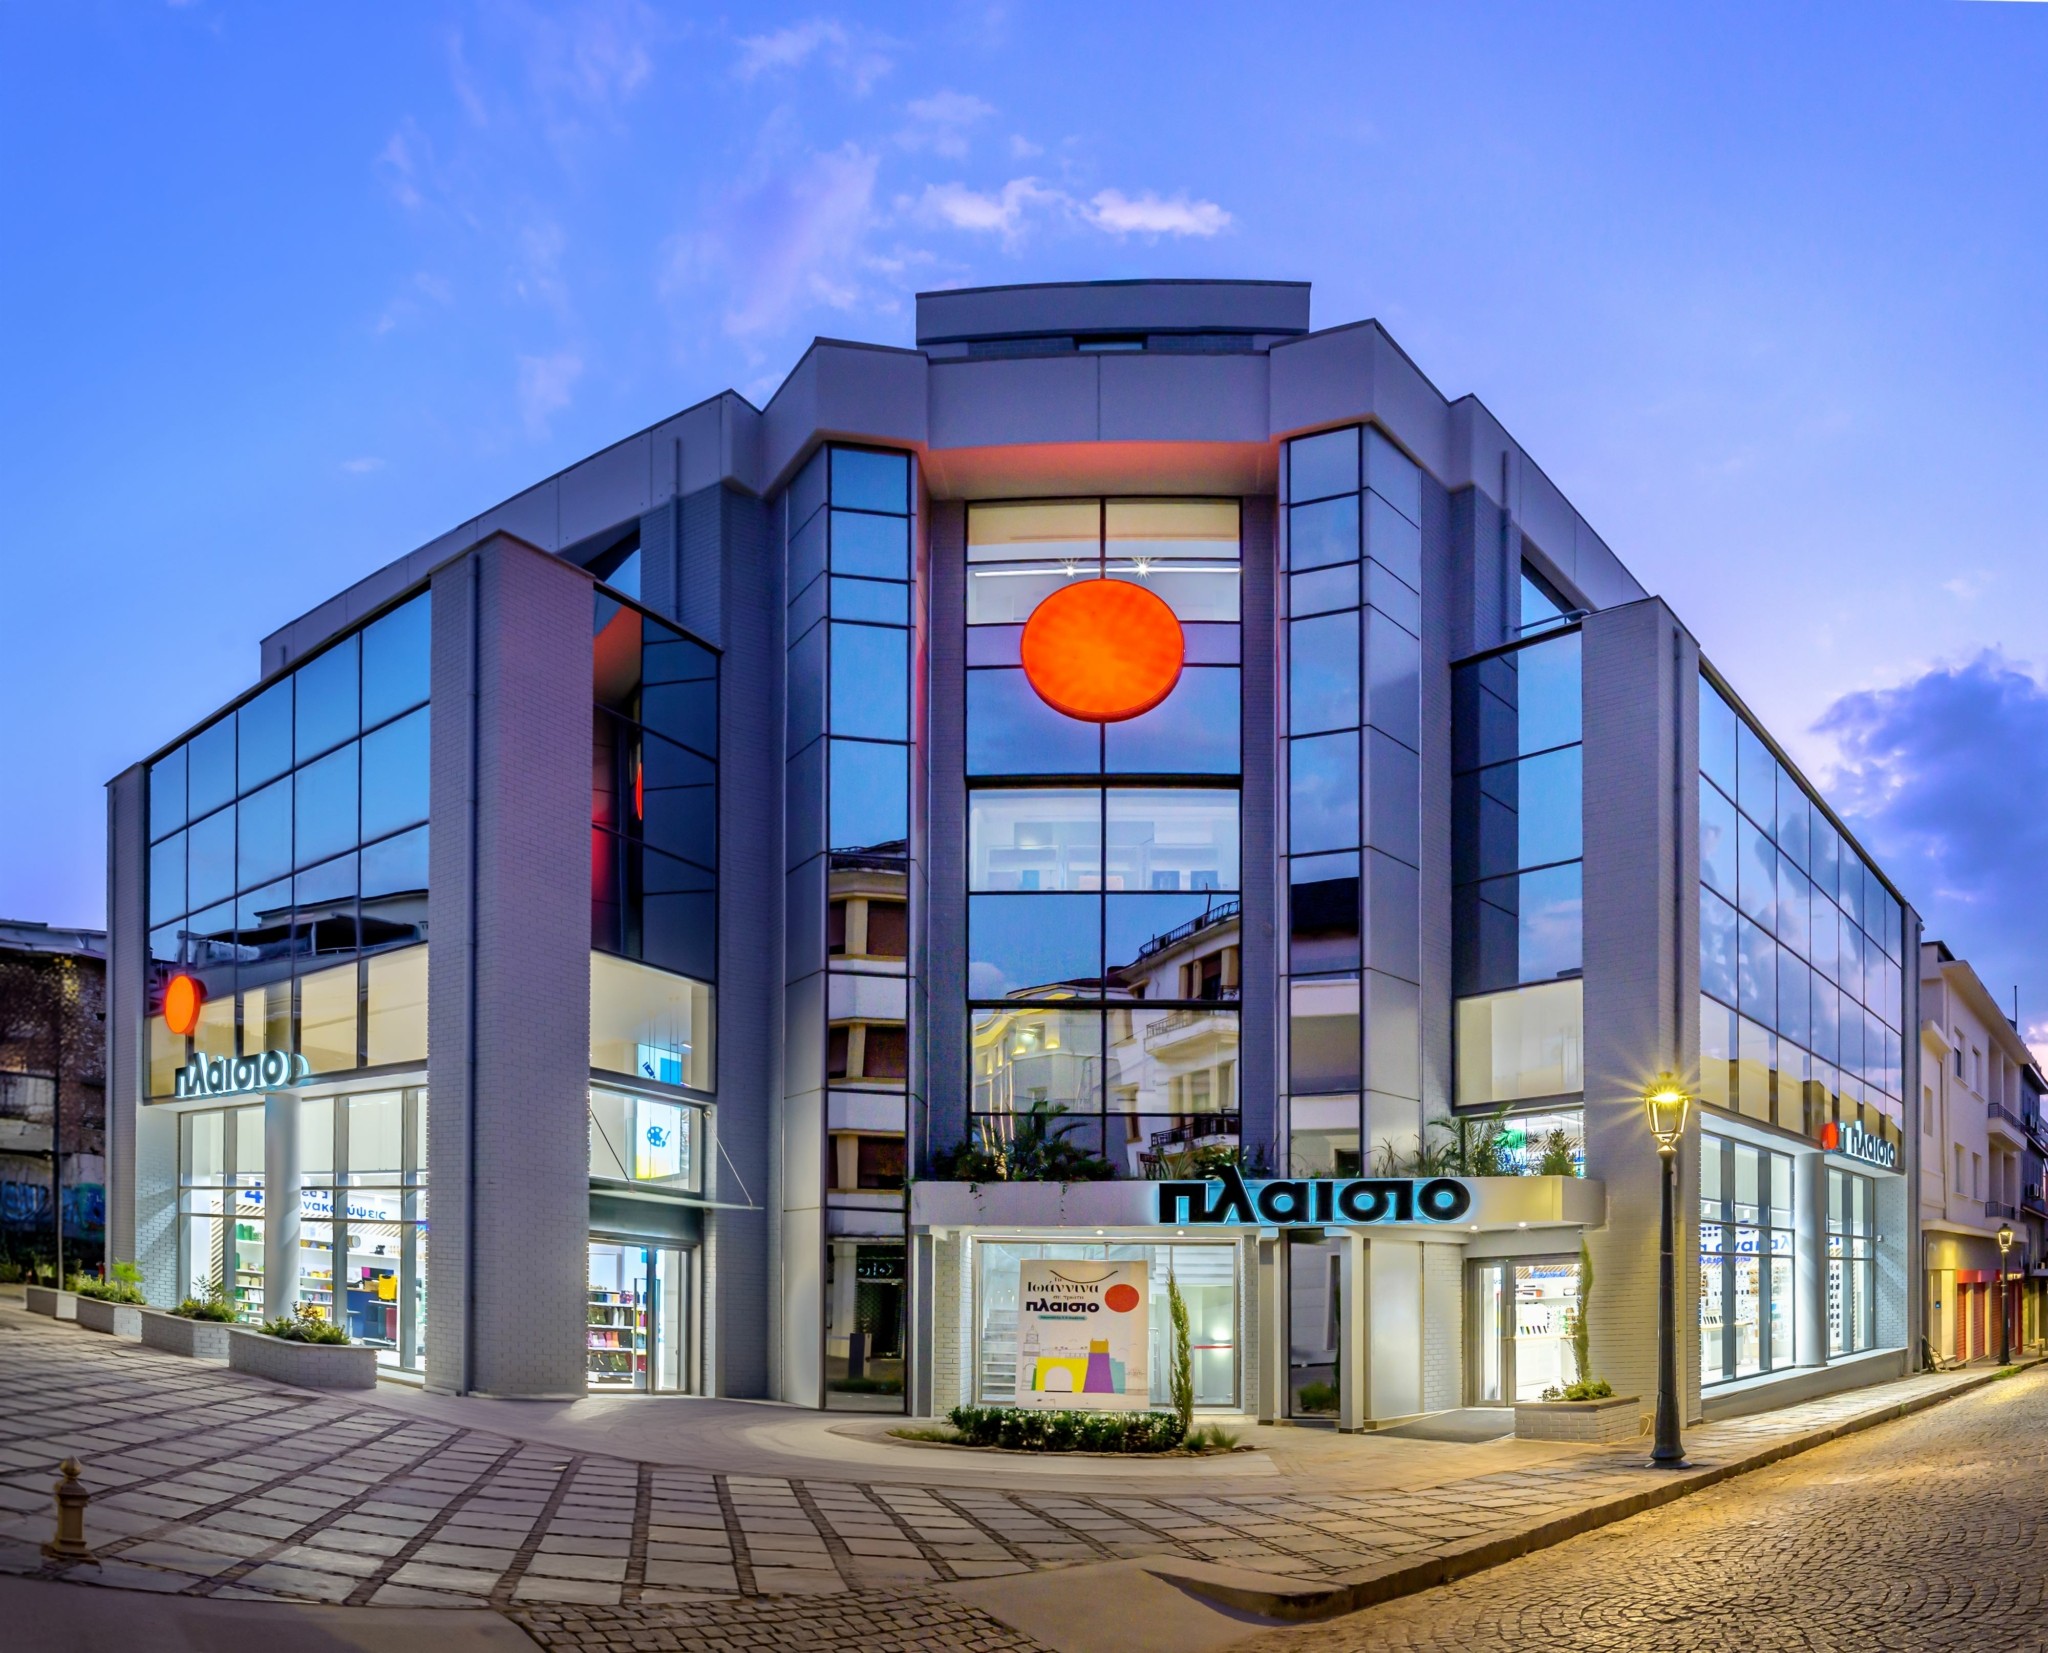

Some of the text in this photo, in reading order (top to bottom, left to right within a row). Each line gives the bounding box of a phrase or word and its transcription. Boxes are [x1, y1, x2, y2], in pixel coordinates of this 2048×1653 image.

[1158, 1165, 1472, 1225] πλαισιο
[1027, 1280, 1099, 1294] Ιωάννινα
[1025, 1298, 1100, 1313] πλαισιο
